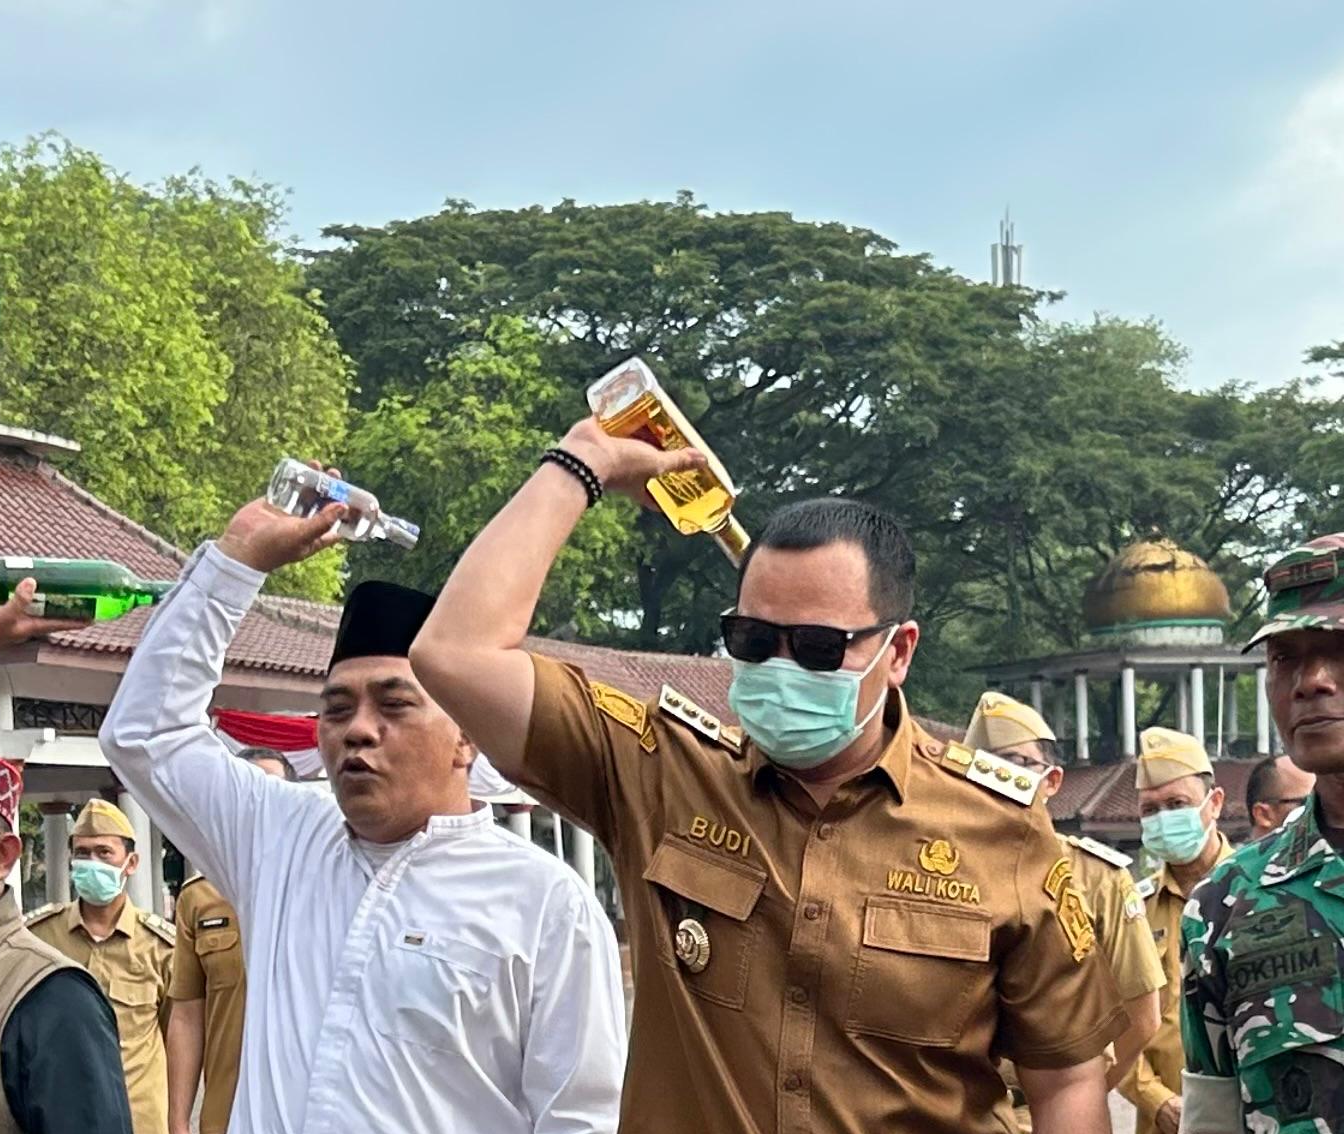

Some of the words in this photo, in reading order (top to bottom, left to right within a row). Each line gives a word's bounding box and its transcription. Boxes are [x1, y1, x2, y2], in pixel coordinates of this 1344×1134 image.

[689, 816, 752, 858] BUDI
[886, 870, 934, 895] WALI
[935, 877, 981, 904] KOTA
[1234, 946, 1320, 989] OKHIM
